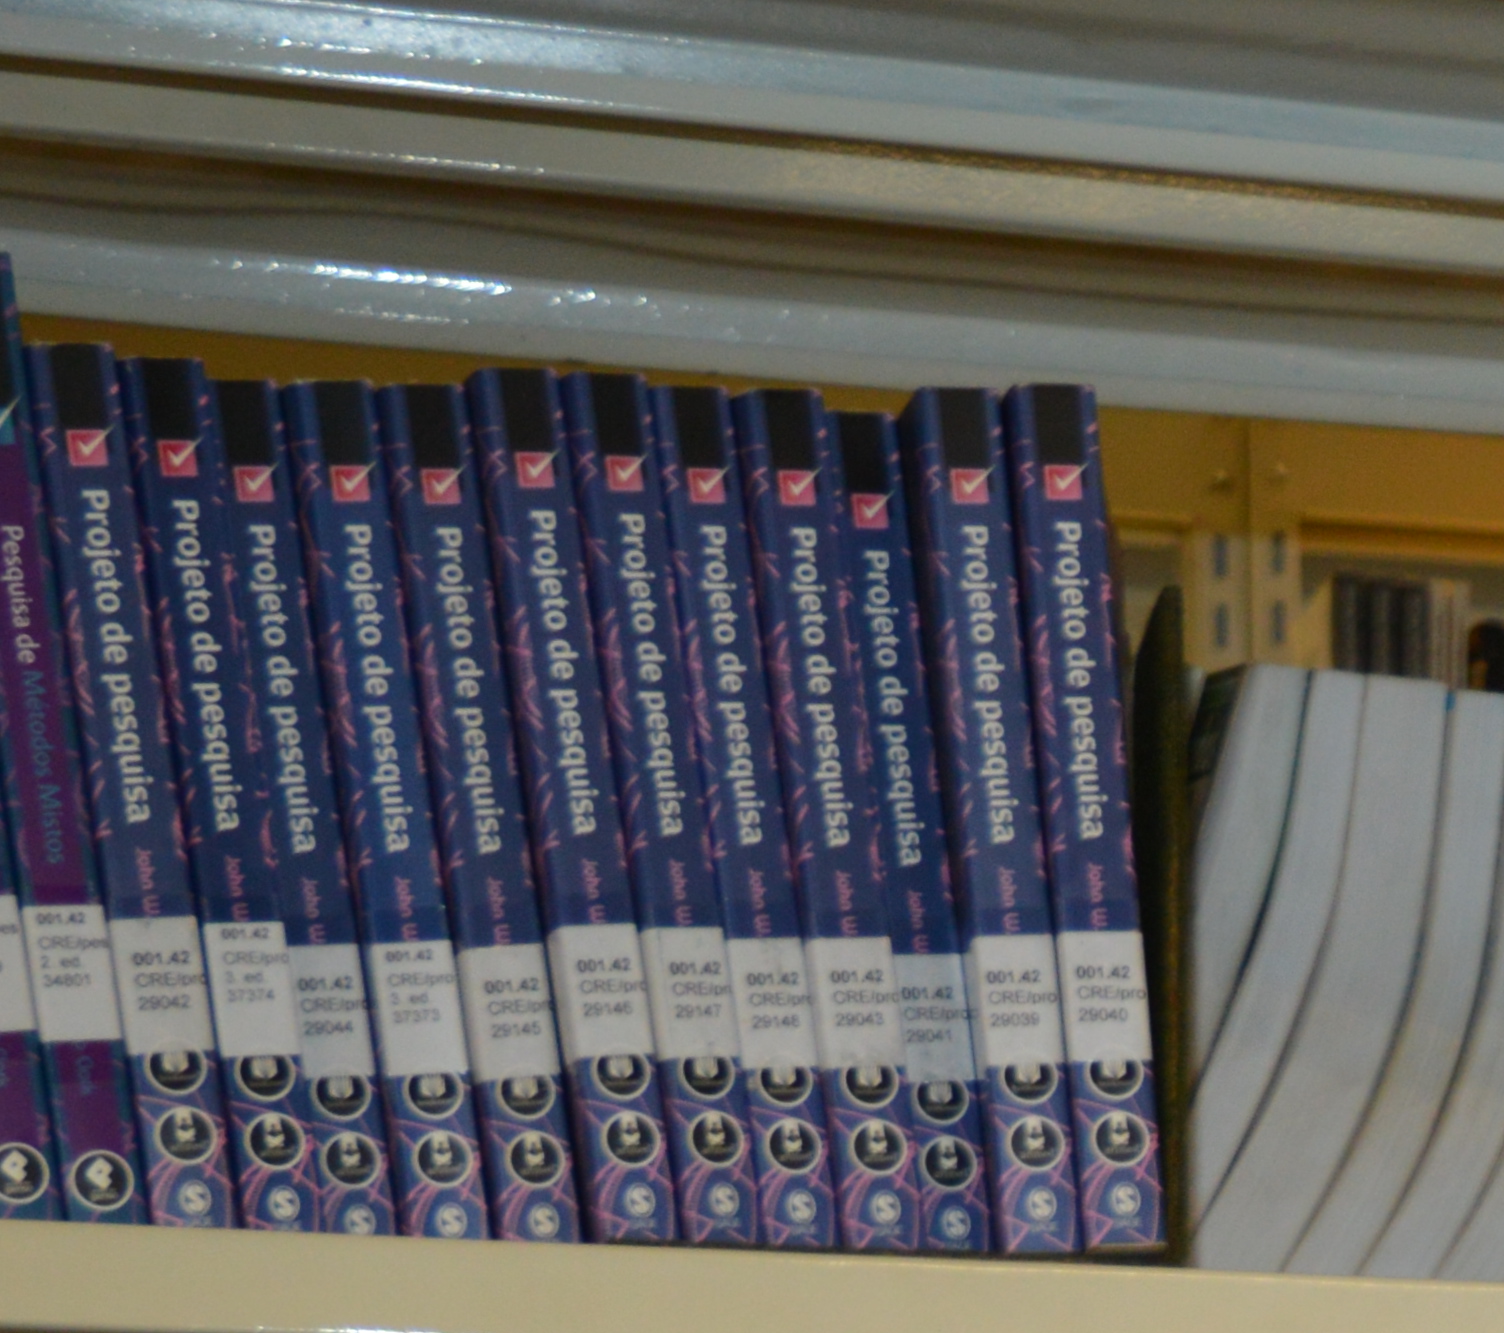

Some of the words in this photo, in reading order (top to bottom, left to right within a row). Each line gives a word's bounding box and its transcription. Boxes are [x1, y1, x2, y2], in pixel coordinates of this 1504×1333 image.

[2, 524, 31, 627] Pesquisa
[82, 490, 122, 613] Projeto
[249, 524, 287, 646] Projeto
[529, 509, 567, 630] Projeto
[701, 525, 736, 645] Projeto
[863, 550, 899, 669] Projeto
[1054, 521, 1089, 640] Projeto
[16, 631, 41, 664] de
[101, 622, 133, 664] de
[268, 655, 298, 697] de
[548, 639, 579, 680] de
[716, 653, 747, 693] de
[879, 676, 909, 716] de
[1065, 647, 1096, 688] de
[102, 673, 153, 823] pesquisa
[270, 706, 318, 854] pesquisa
[549, 689, 598, 836] pesquisa
[718, 702, 765, 846] pesquisa
[879, 724, 925, 867] pesquisa
[1065, 697, 1108, 839] pesquisa
[577, 957, 631, 974] 001.42
[669, 960, 721, 976] 001.42
[1076, 964, 1130, 980] 001.42
